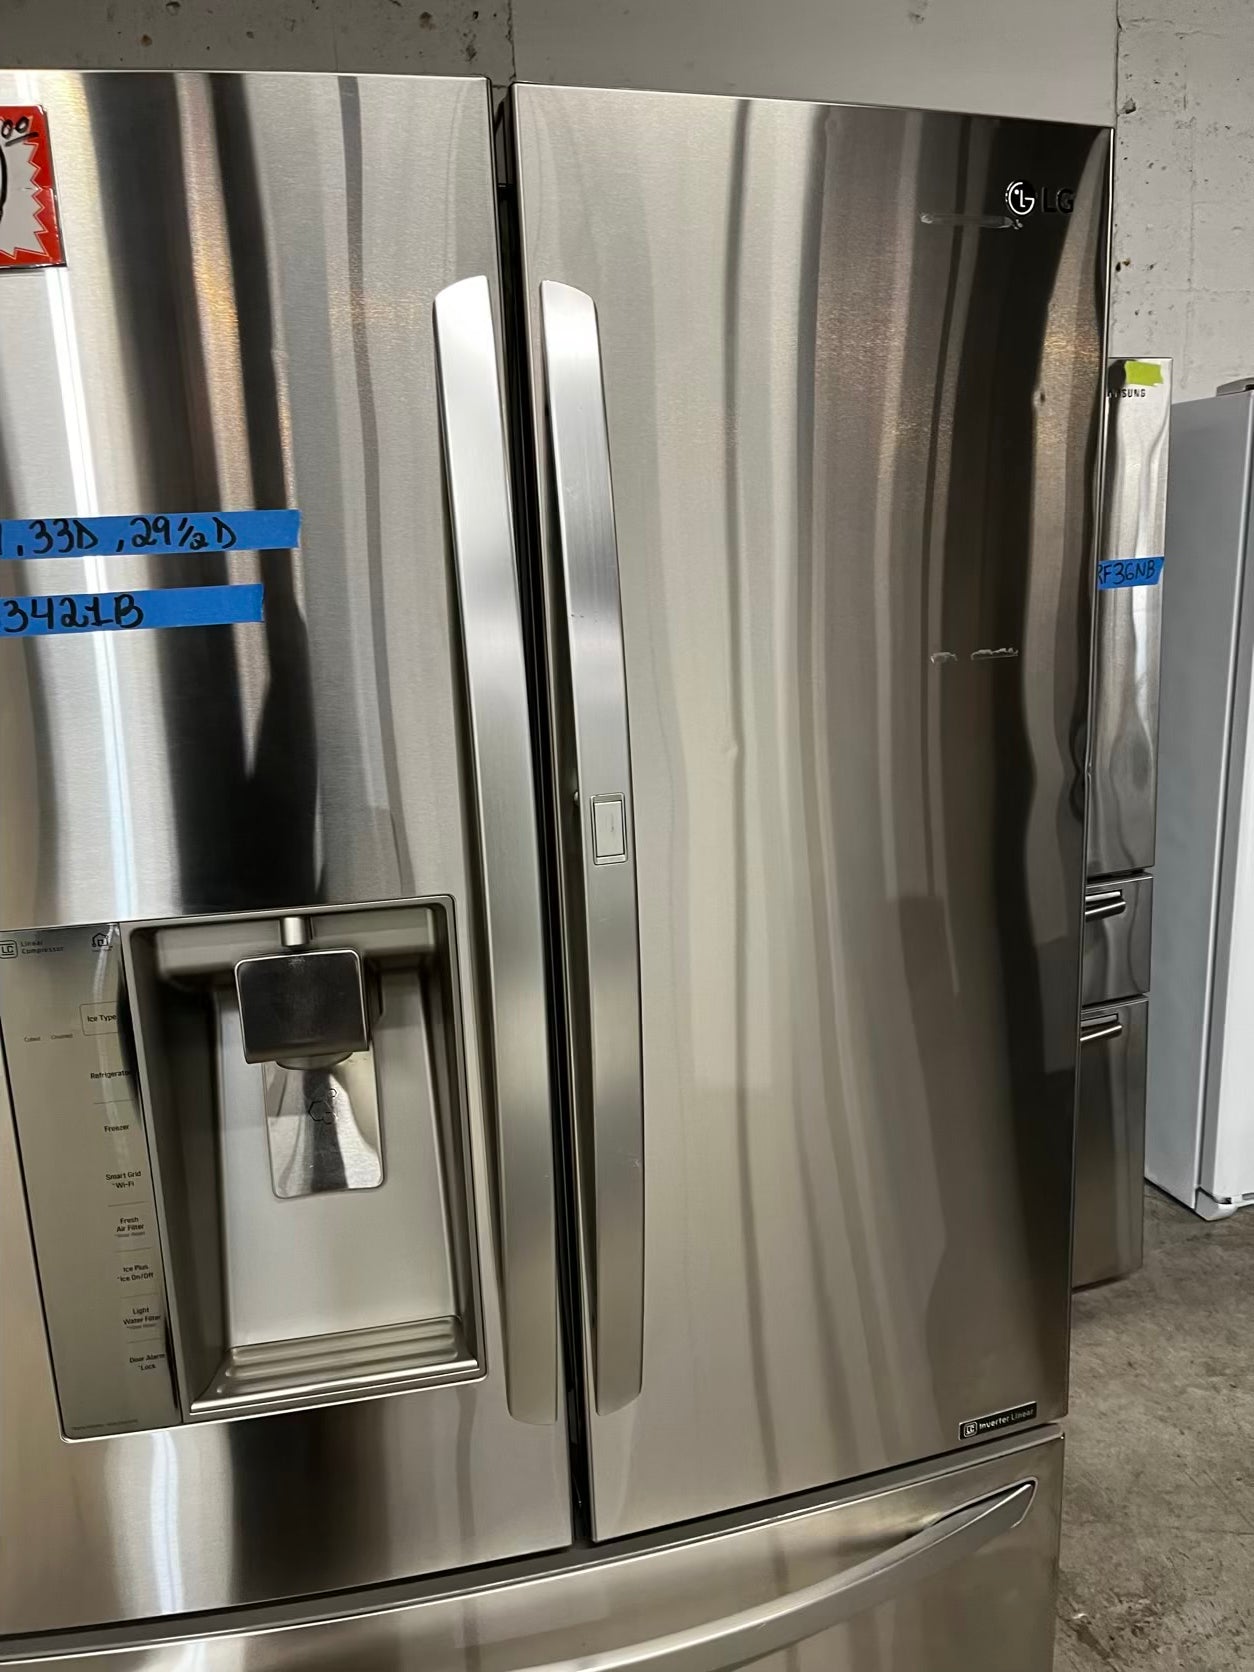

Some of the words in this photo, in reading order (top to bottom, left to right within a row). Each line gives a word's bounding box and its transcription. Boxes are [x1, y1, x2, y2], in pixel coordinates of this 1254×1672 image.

[100, 1014, 117, 1022] Type
[90, 1070, 131, 1079] Refrigerato
[105, 1172, 126, 1180] Smart
[132, 1272, 154, 1280] On/Off
[132, 1307, 150, 1315] Light
[980, 1416, 1010, 1430] Inverter
[1011, 1409, 1034, 1420] Linear
